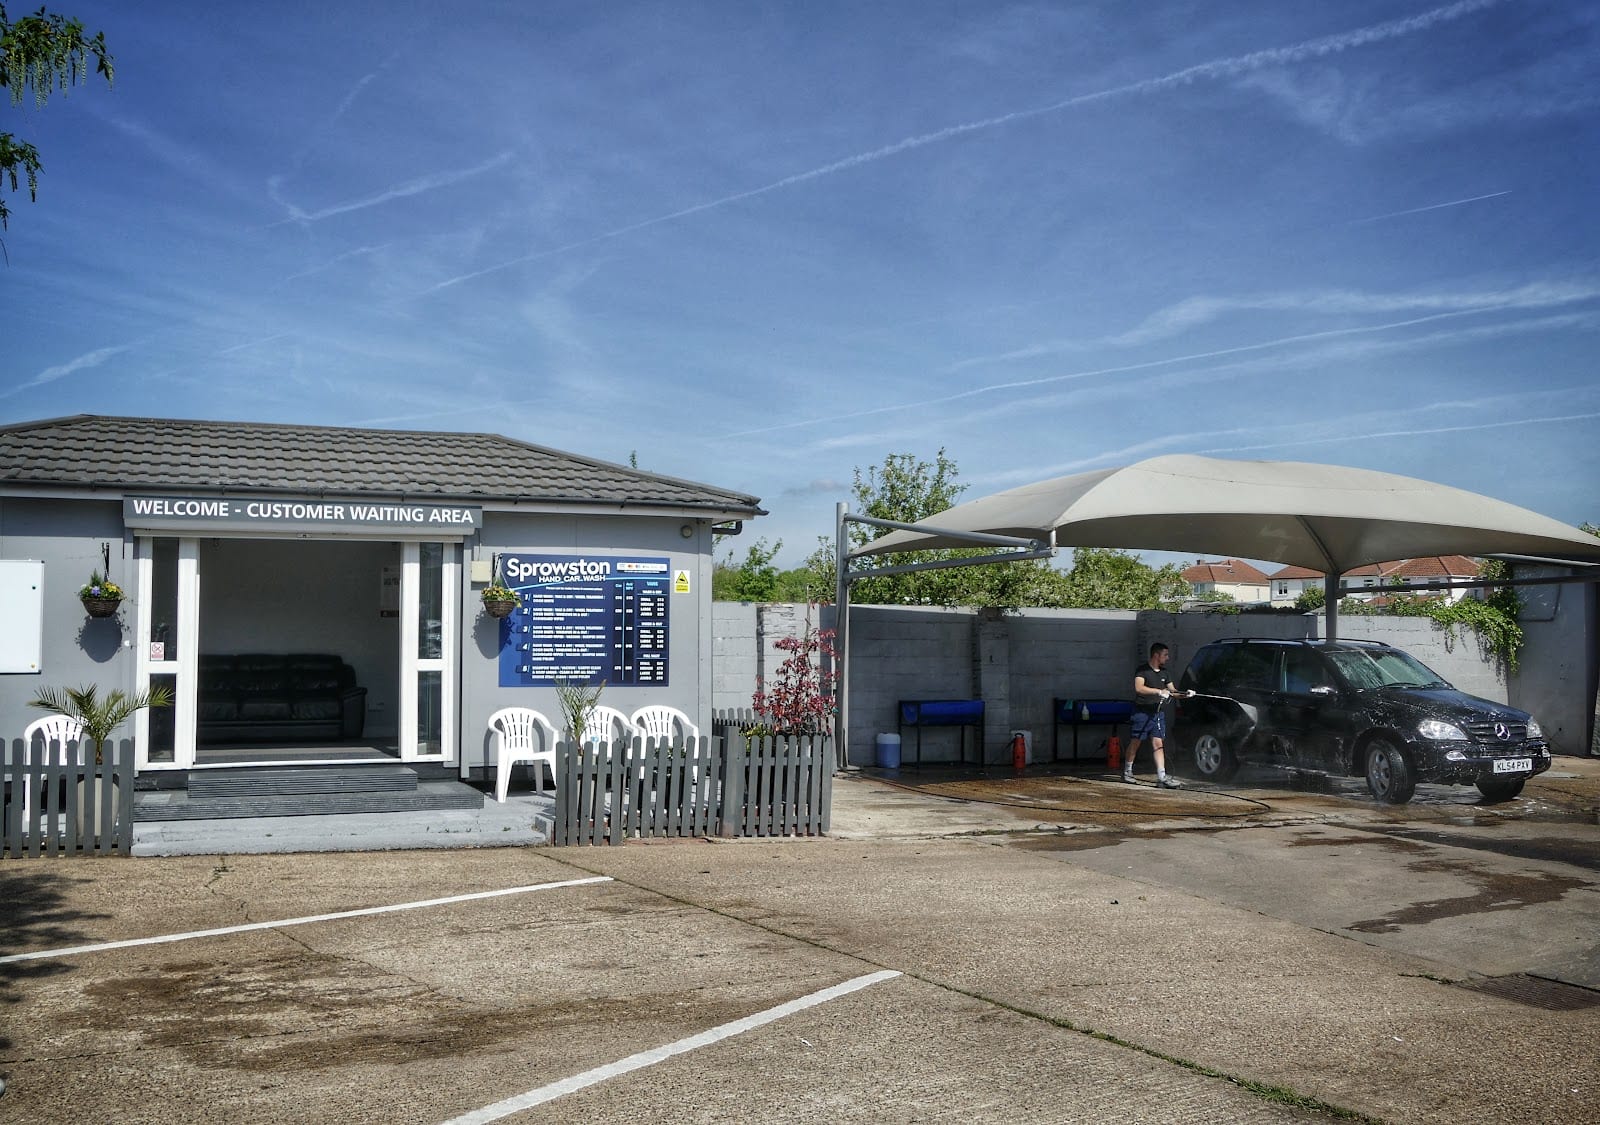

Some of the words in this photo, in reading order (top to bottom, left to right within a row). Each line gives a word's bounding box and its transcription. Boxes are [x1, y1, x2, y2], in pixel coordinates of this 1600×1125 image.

[133, 499, 229, 518] WELCOME
[246, 502, 345, 521] CUSTOMER
[349, 505, 424, 523] WAITING
[429, 507, 474, 524] AREA
[506, 557, 611, 582] Sprowston
[1497, 761, 1516, 771] KL54
